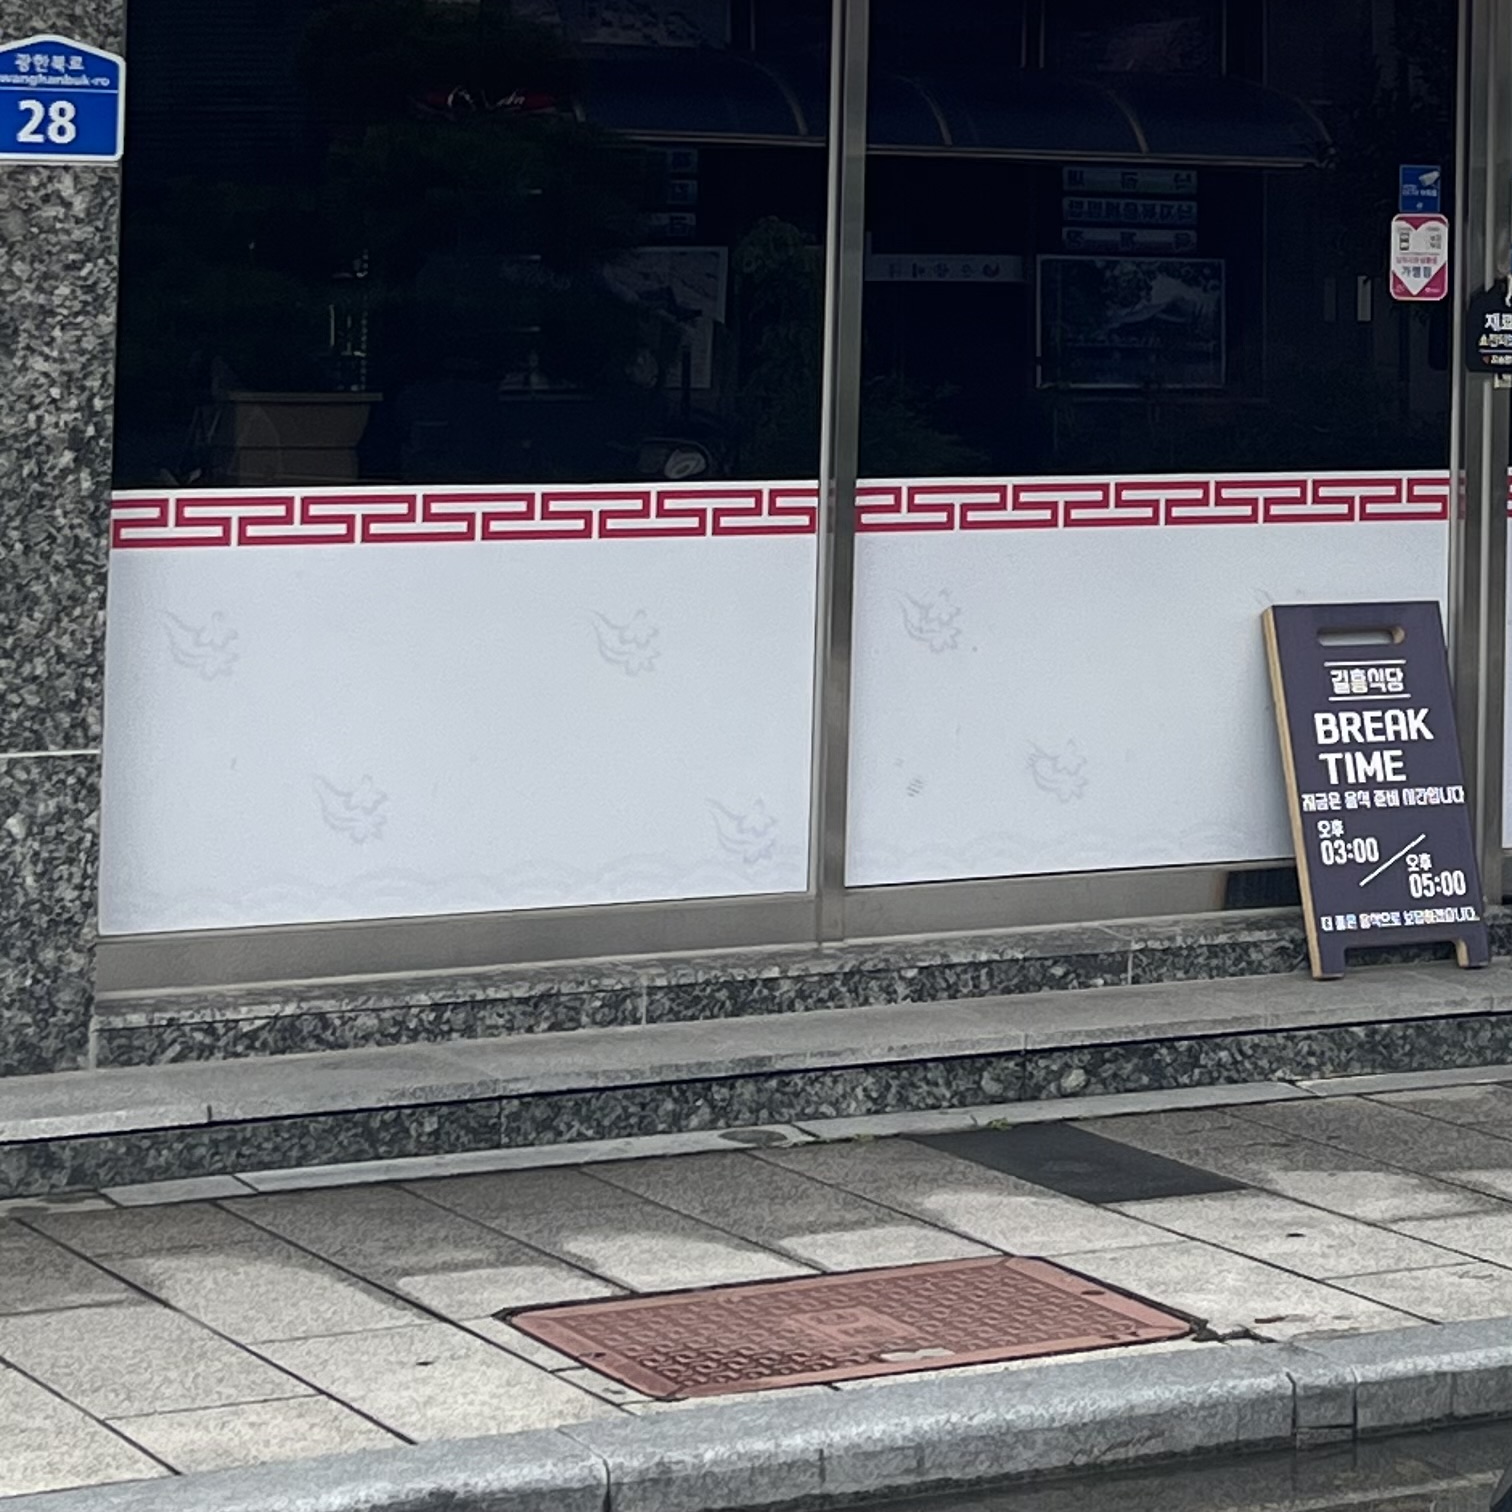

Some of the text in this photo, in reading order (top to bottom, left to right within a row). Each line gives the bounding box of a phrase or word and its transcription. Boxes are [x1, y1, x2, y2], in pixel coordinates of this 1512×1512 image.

[0, 73, 111, 87] wanghanbuk-ro
[16, 98, 77, 144] 28
[1330, 666, 1405, 694] 길흥식당
[1313, 707, 1435, 745] BREAK
[1318, 750, 1407, 785] TIME
[1301, 791, 1342, 812] 지금은
[1344, 789, 1371, 809] 음식
[1373, 788, 1400, 808] 준비
[1317, 819, 1344, 838] 오후
[1320, 837, 1380, 865] 03:00
[1405, 853, 1432, 872] 오후
[1408, 870, 1467, 898] 05:00
